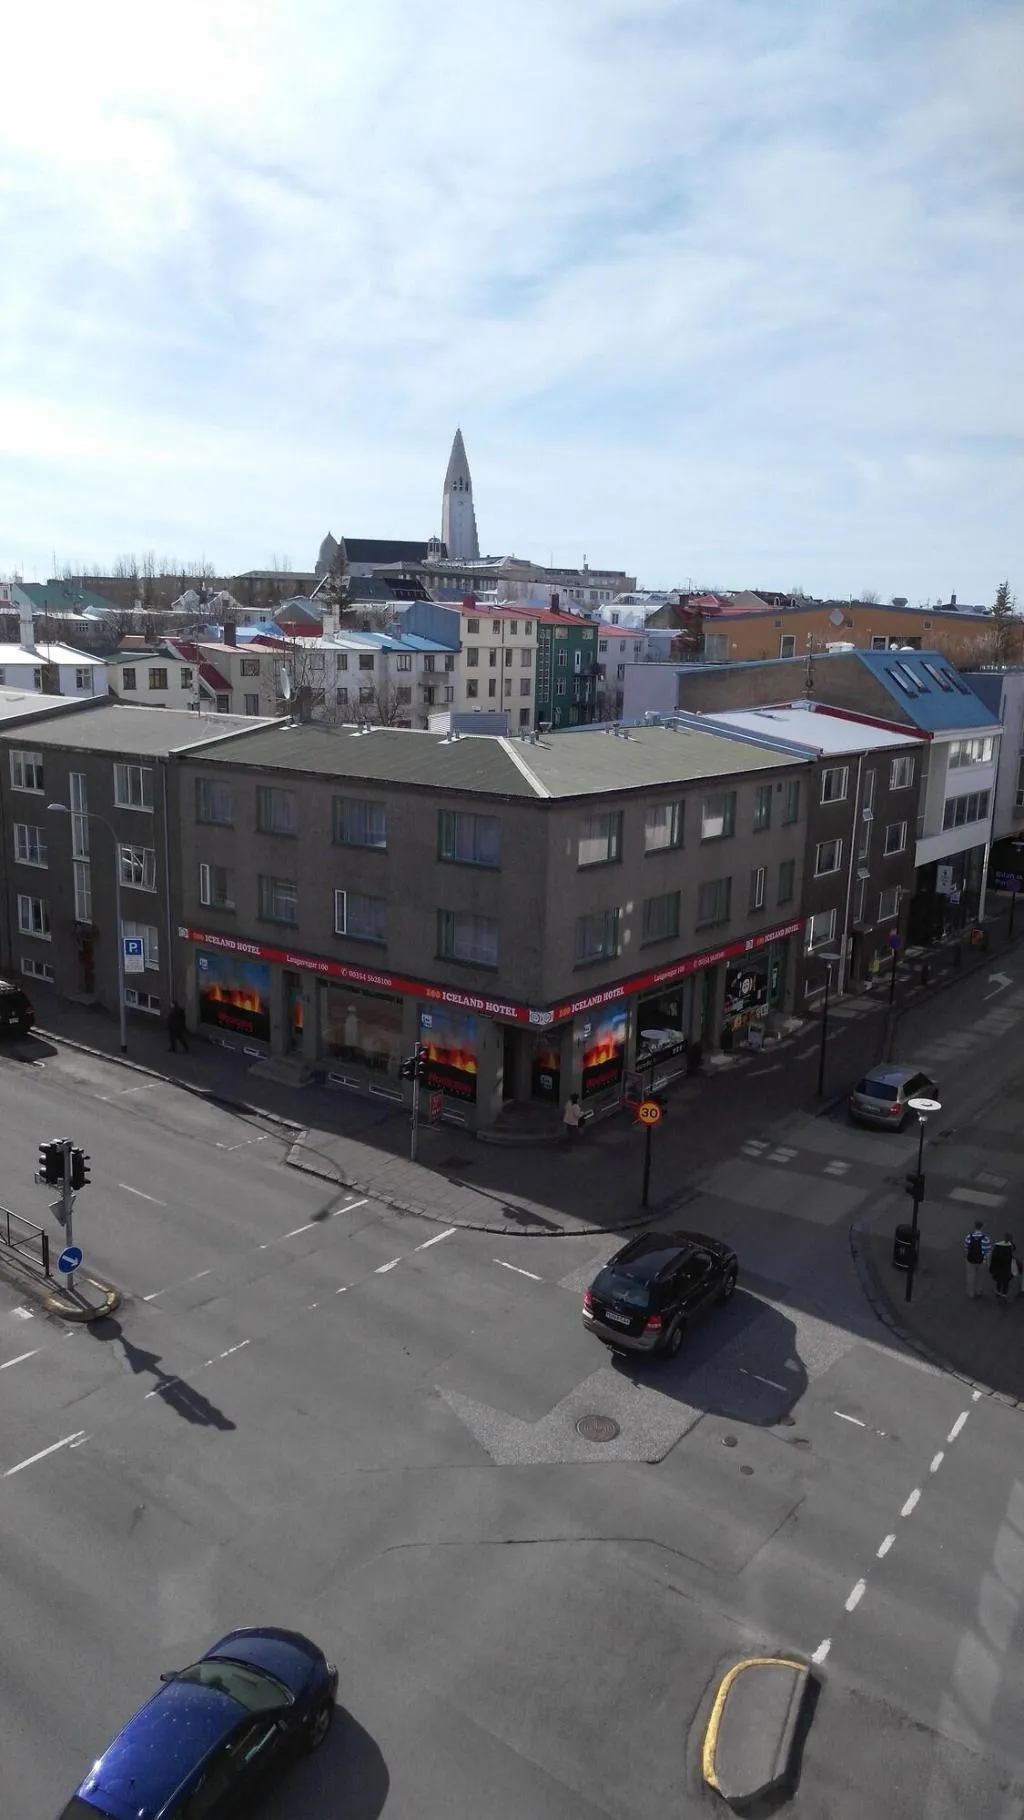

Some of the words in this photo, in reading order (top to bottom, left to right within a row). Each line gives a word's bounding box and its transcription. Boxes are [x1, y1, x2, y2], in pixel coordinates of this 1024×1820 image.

[129, 943, 138, 953] P
[205, 934, 236, 949] ICELAND
[237, 942, 261, 955] HOTEL
[442, 991, 484, 1009] ICELAND
[485, 1001, 518, 1018] HOTEL
[571, 994, 603, 1013] ICELAND
[603, 986, 625, 1002] HOTEL
[641, 1108, 658, 1118] 30
